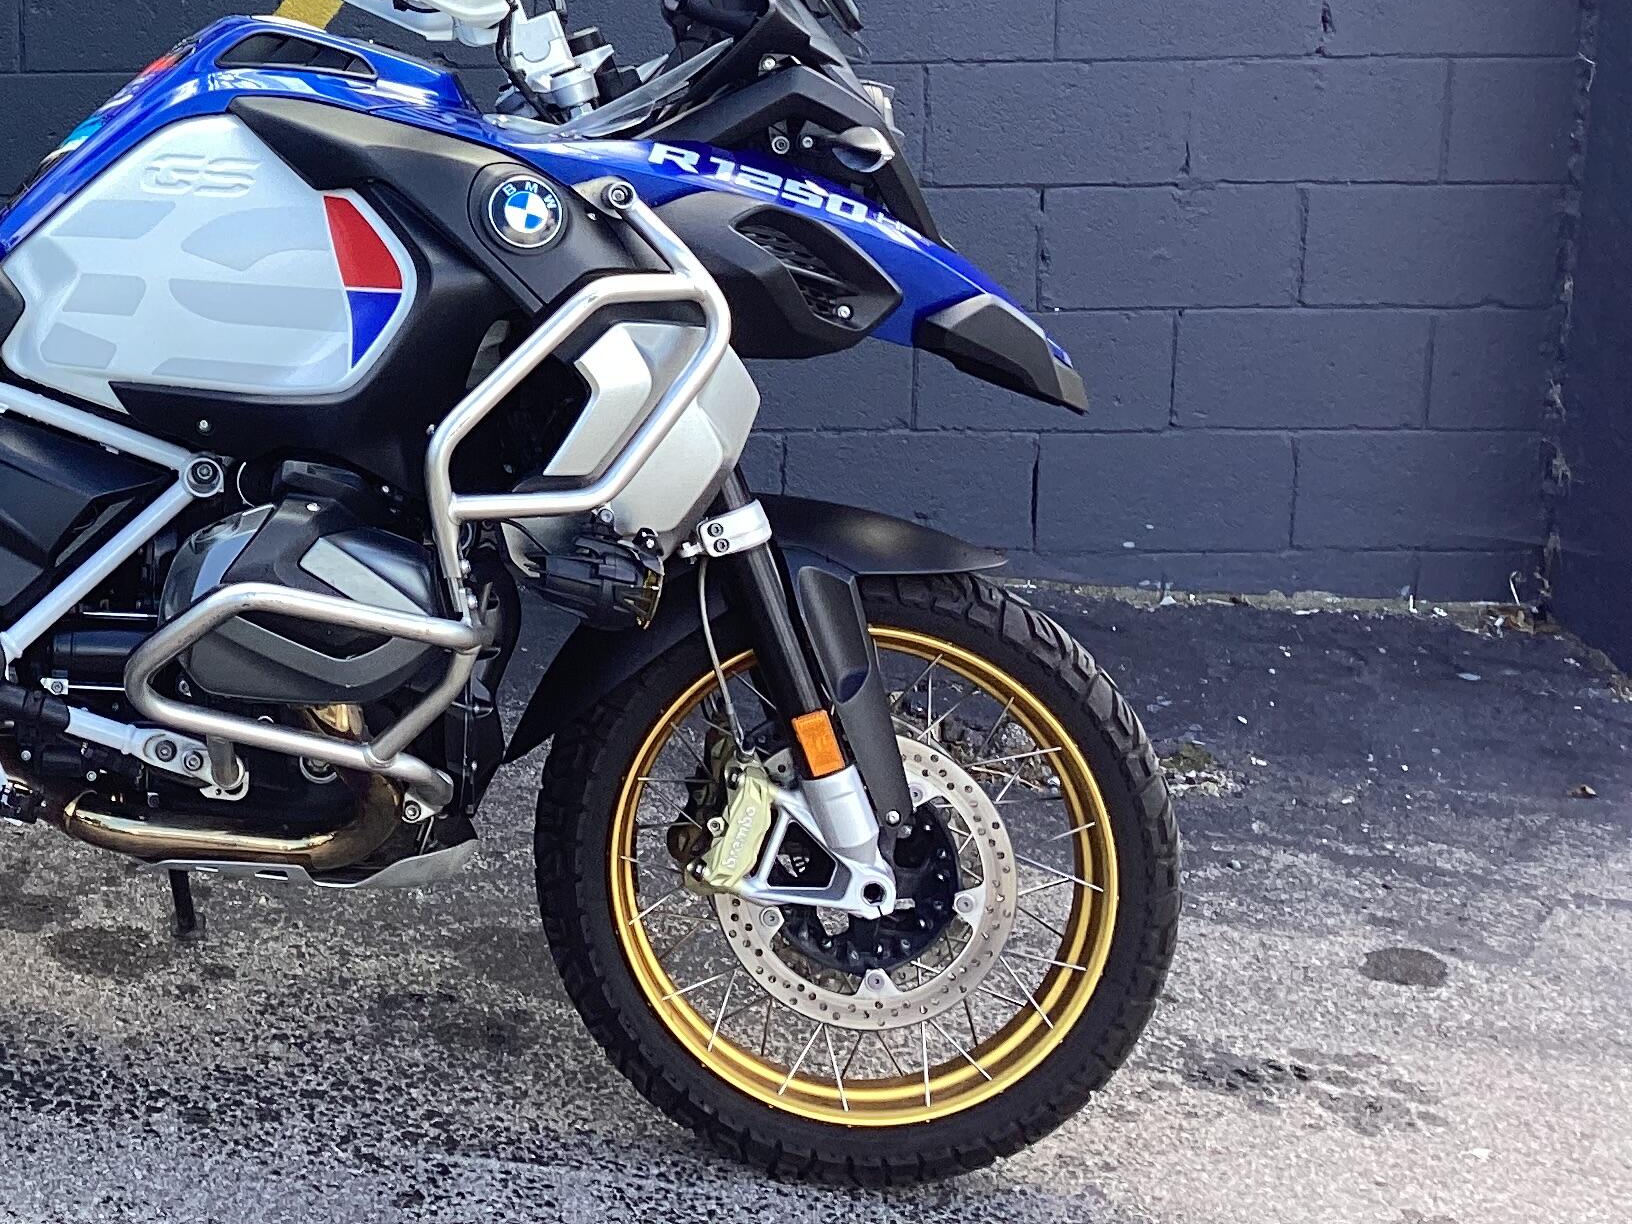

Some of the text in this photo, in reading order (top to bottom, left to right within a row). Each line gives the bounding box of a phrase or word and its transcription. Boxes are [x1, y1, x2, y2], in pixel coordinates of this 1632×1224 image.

[140, 152, 263, 199] GS
[501, 181, 558, 209] BMW
[721, 805, 757, 869] brembo
